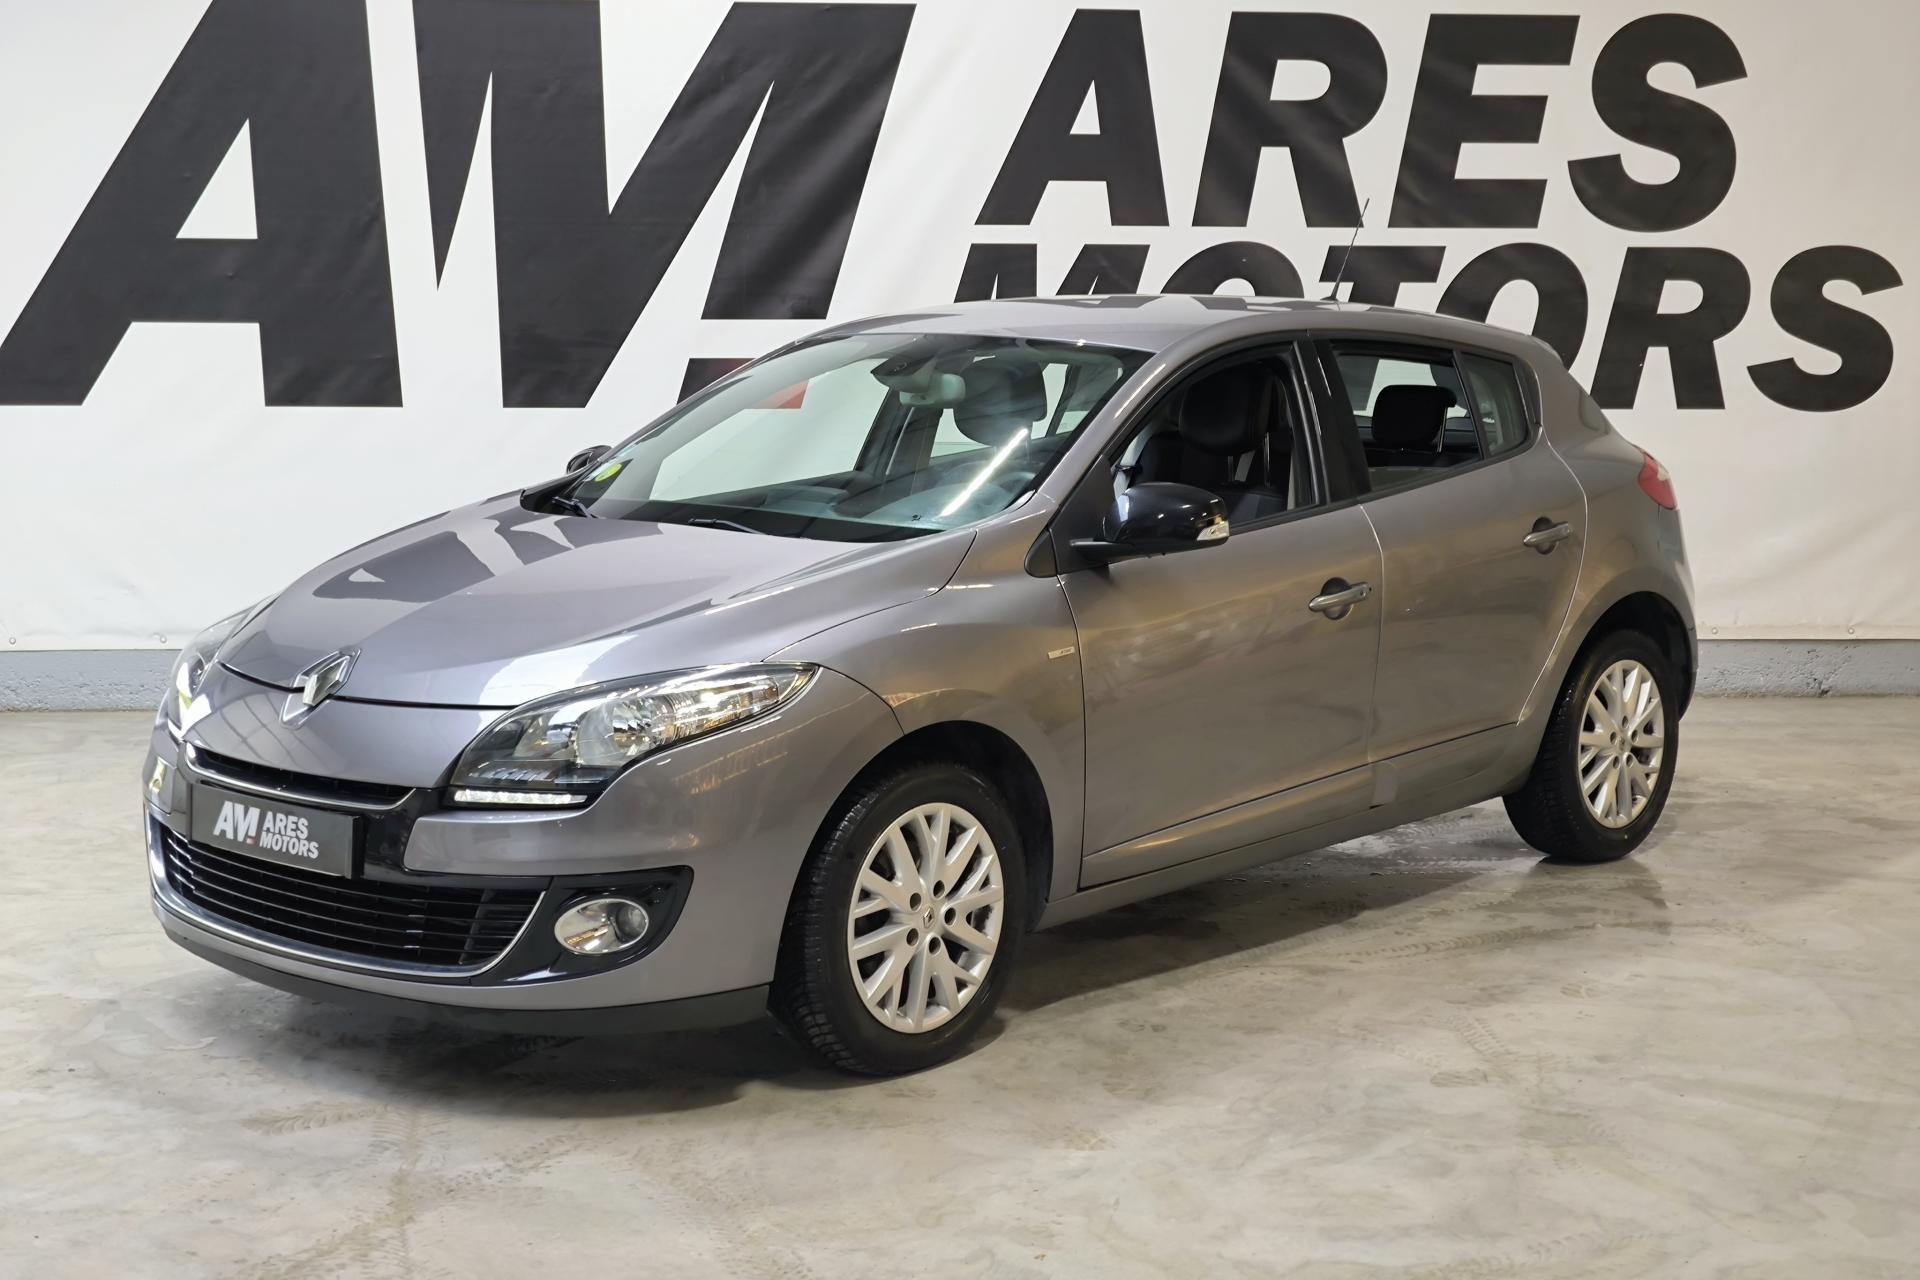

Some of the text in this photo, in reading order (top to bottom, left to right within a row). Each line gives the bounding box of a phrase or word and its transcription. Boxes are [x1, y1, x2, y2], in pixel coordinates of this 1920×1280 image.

[974, 8, 1748, 232] ARES
[264, 811, 308, 840] ARES
[260, 832, 319, 858] MOTORS
